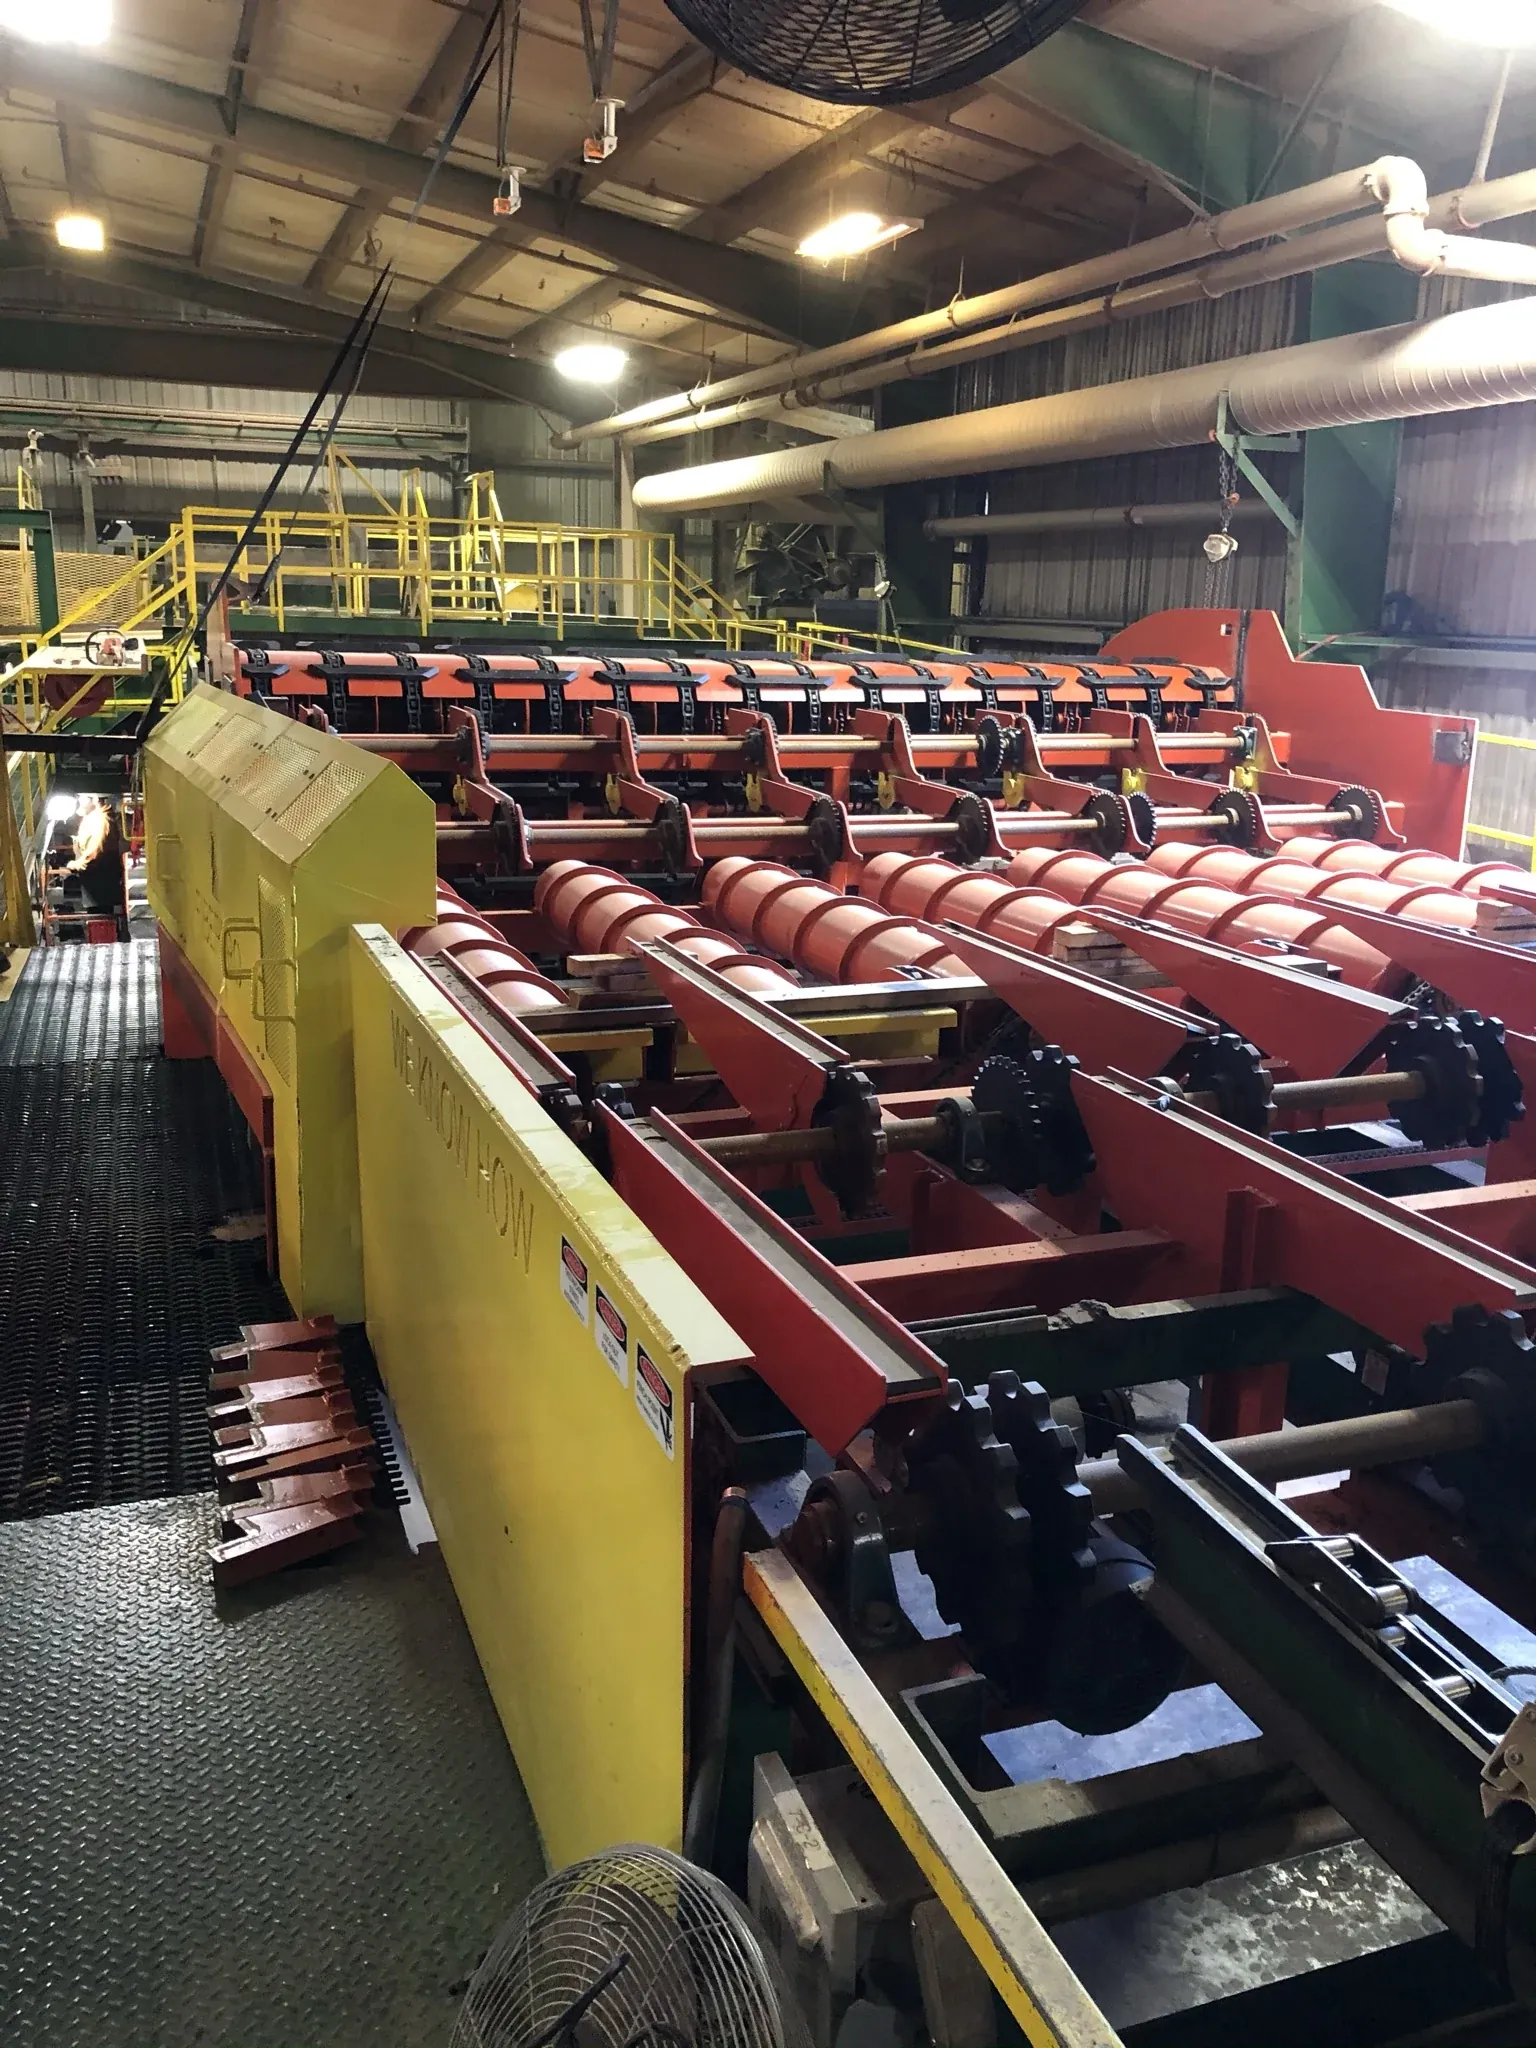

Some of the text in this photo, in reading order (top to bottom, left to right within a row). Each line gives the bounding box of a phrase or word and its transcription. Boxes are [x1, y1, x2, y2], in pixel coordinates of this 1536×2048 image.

[391, 1009, 535, 1275] WE KNOW HOW
